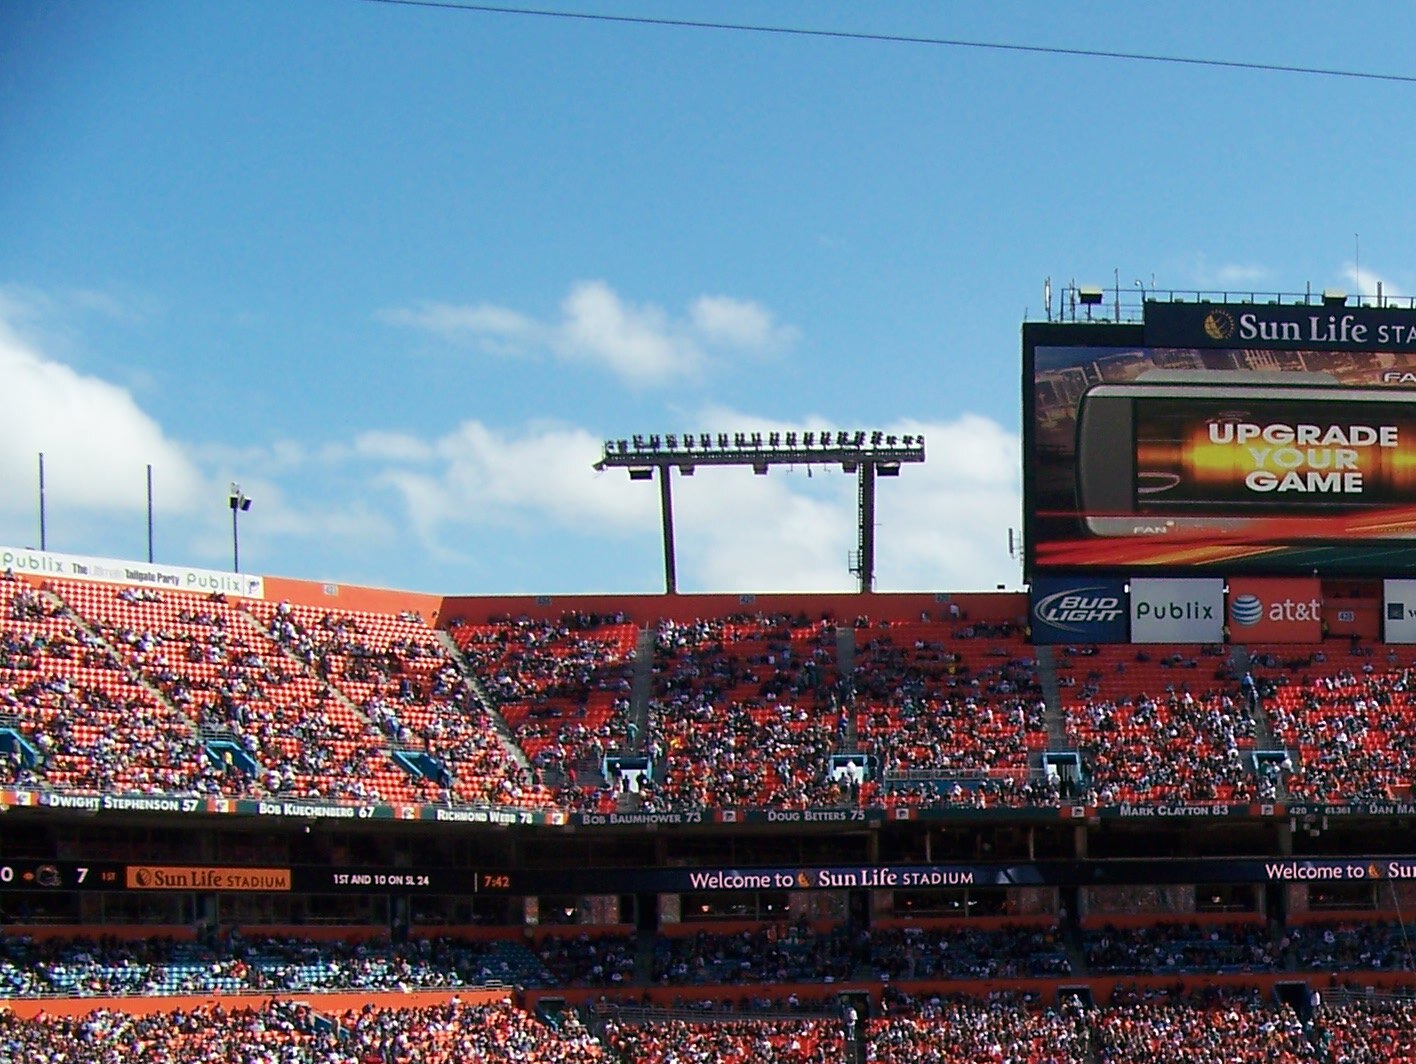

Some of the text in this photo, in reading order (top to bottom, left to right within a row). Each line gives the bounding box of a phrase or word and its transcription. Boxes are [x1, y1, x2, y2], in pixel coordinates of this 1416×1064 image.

[1239, 313, 1301, 341] Sun
[1308, 315, 1368, 343] Life
[1208, 422, 1399, 447] UPGRADE
[1248, 448, 1359, 470] YOUR
[1244, 471, 1363, 493] GAME
[3, 551, 64, 573] Publix
[72, 562, 89, 575] The
[125, 568, 156, 584] Tailgate
[157, 572, 180, 587] Party
[186, 572, 242, 592] Publix
[1058, 596, 1120, 609] BUD
[1136, 602, 1213, 620] Publix
[1269, 598, 1321, 621] at&t
[1046, 609, 1124, 622] LIGHT
[49, 794, 199, 812] DWIGHT STEPHENSON 57
[258, 803, 281, 816] BOB
[358, 806, 376, 818] 67
[1120, 804, 1229, 817] MARK CLAYTON 83
[1369, 803, 1394, 815] DAN
[437, 809, 487, 823] RICHMOND
[520, 813, 534, 824] 78
[582, 812, 702, 825] BOB BAUMHOWER 73
[768, 810, 865, 822] DOUG BETTERS 75
[77, 867, 89, 883] 7
[154, 868, 286, 887] Sun Life STADIUM
[333, 874, 349, 885] 1ST
[351, 874, 371, 885] AND
[374, 874, 386, 885] 10
[388, 874, 404, 886] ON
[417, 875, 429, 886] 24
[690, 868, 974, 889] Welcome to Sun Life STADIUM
[1265, 862, 1342, 880] Welcome
[1346, 863, 1365, 879] to
[483, 876, 510, 888] 7:42
